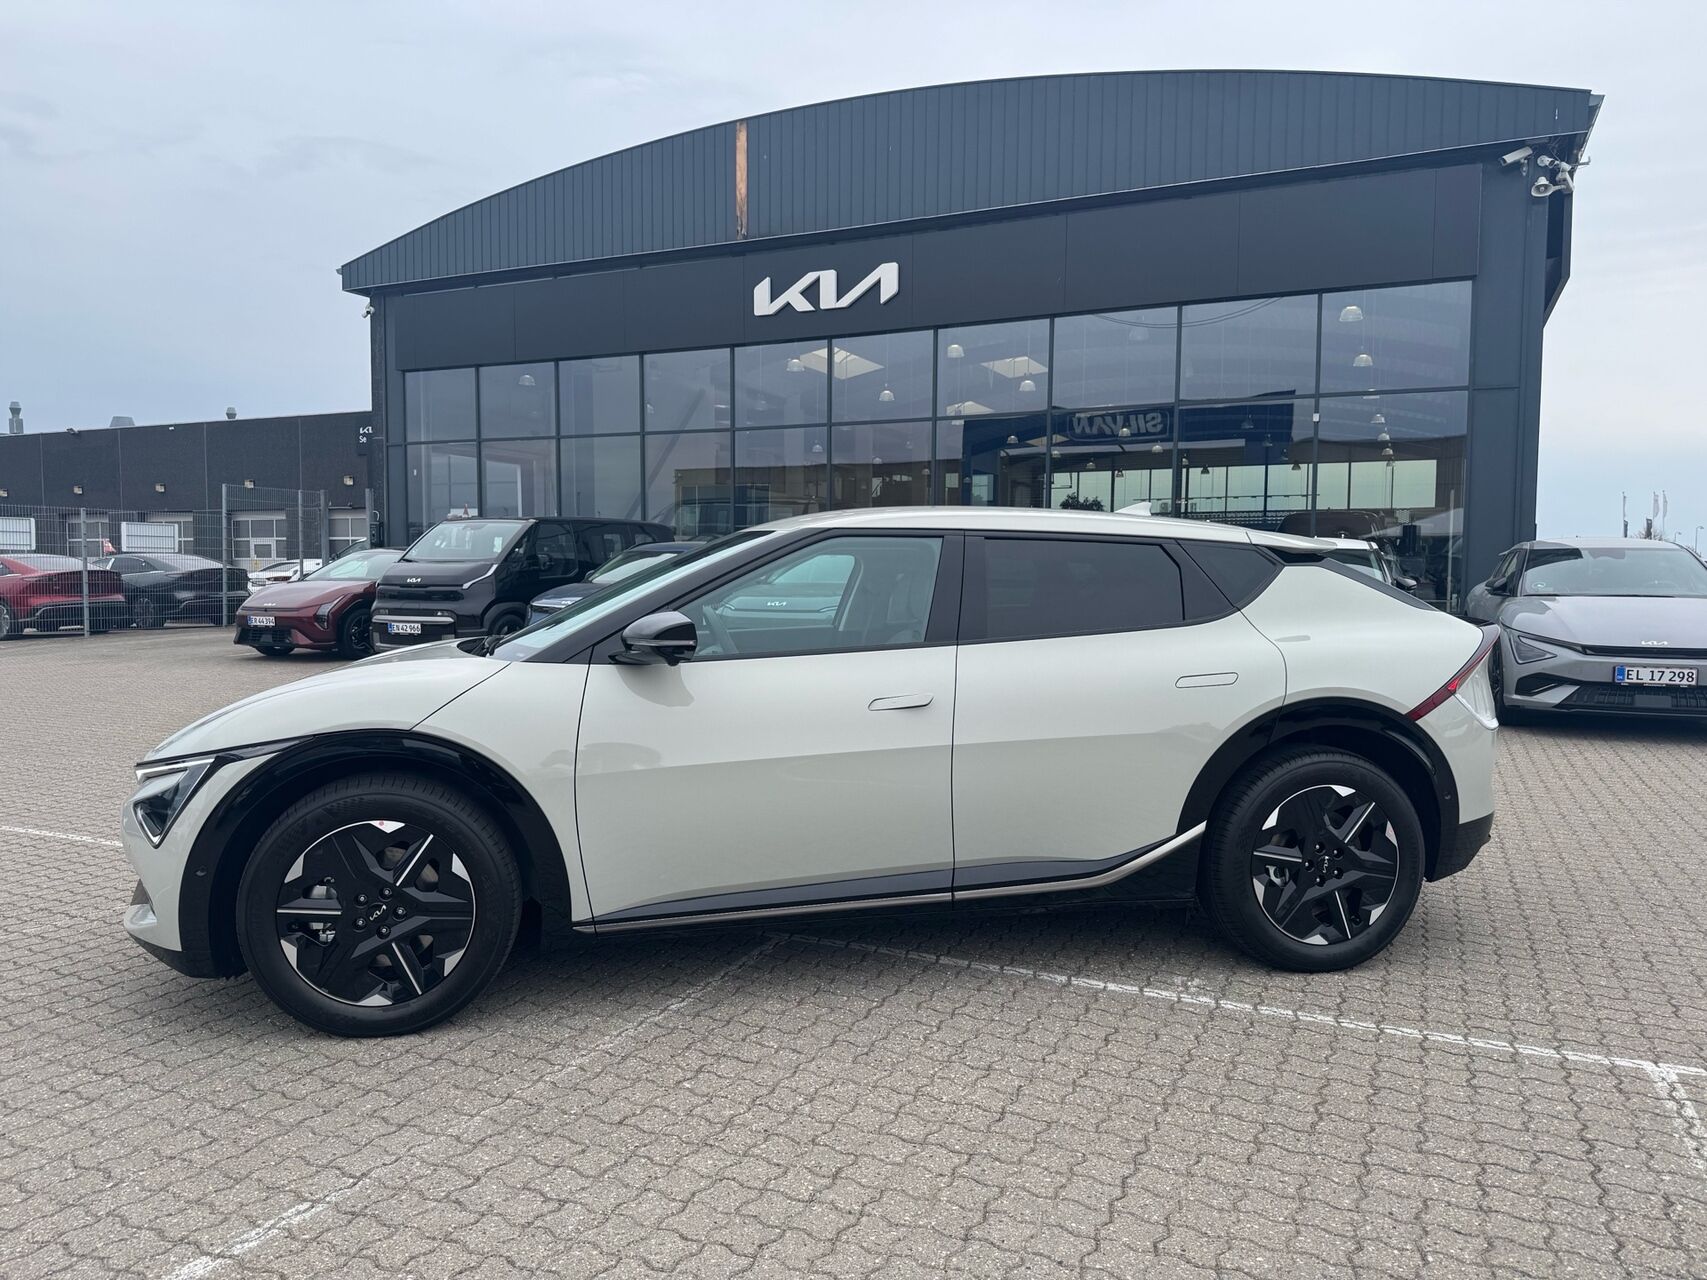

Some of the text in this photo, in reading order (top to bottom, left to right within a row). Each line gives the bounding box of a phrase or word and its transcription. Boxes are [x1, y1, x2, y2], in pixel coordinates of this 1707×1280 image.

[754, 262, 899, 316] KIA
[1626, 669, 1695, 683] EL 17 298
